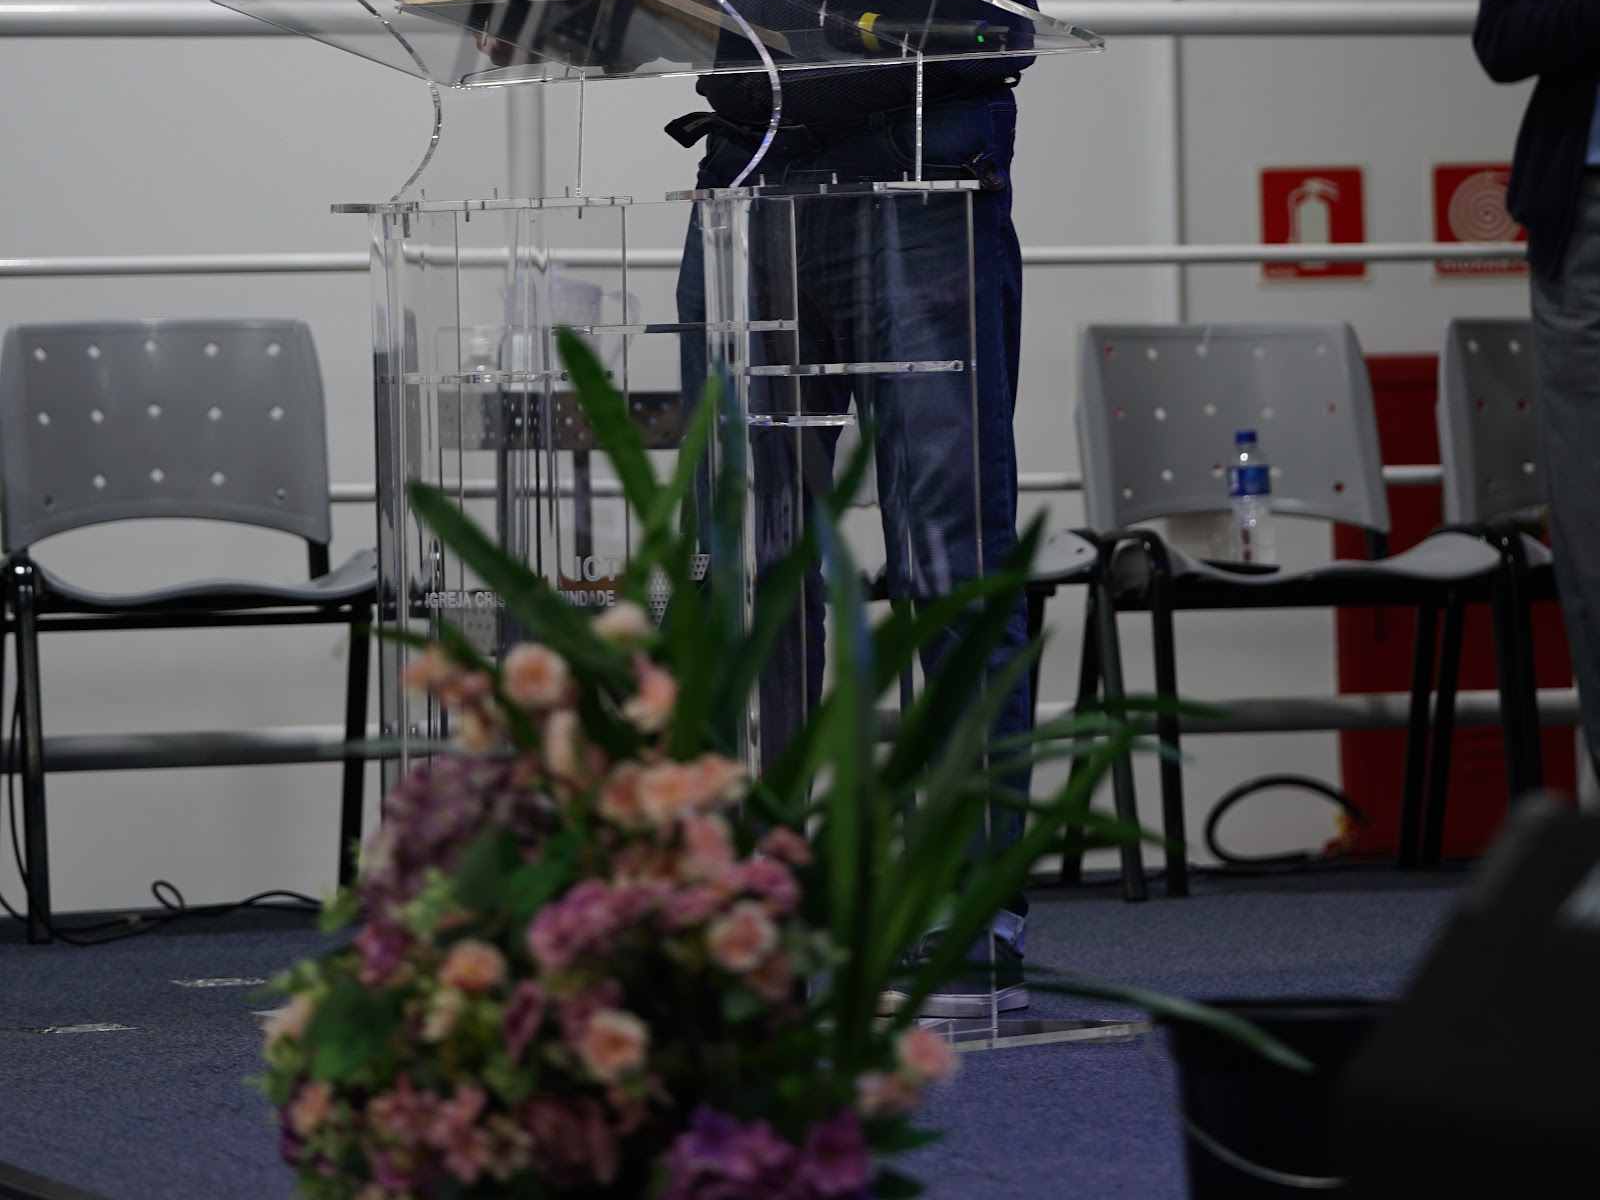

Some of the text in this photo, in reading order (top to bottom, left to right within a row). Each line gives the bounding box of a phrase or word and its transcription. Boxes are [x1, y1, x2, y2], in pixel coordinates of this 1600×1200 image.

[575, 555, 621, 582] ICT
[424, 591, 472, 608] IGREJA
[475, 591, 506, 608] CRIS
